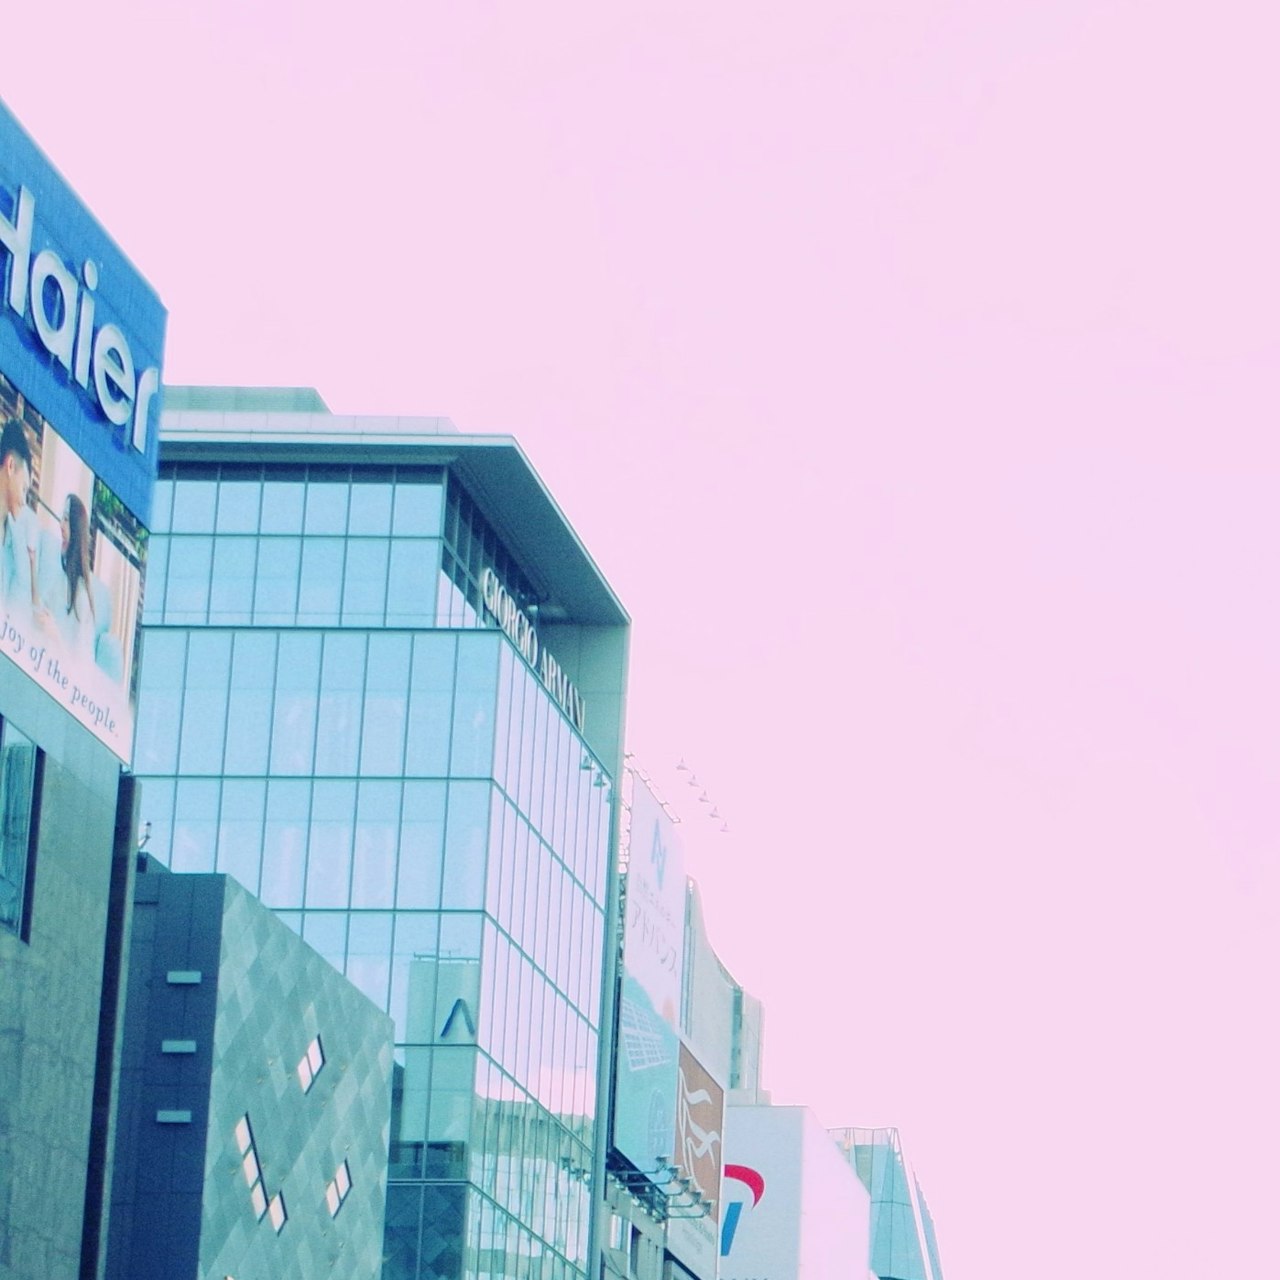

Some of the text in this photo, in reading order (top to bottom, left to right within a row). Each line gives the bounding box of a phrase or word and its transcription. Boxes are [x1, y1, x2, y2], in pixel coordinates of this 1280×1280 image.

[30, 646, 46, 672] of
[47, 660, 69, 690] the
[71, 685, 119, 738] people.
[483, 567, 585, 735] GIORGIO ARMANI
